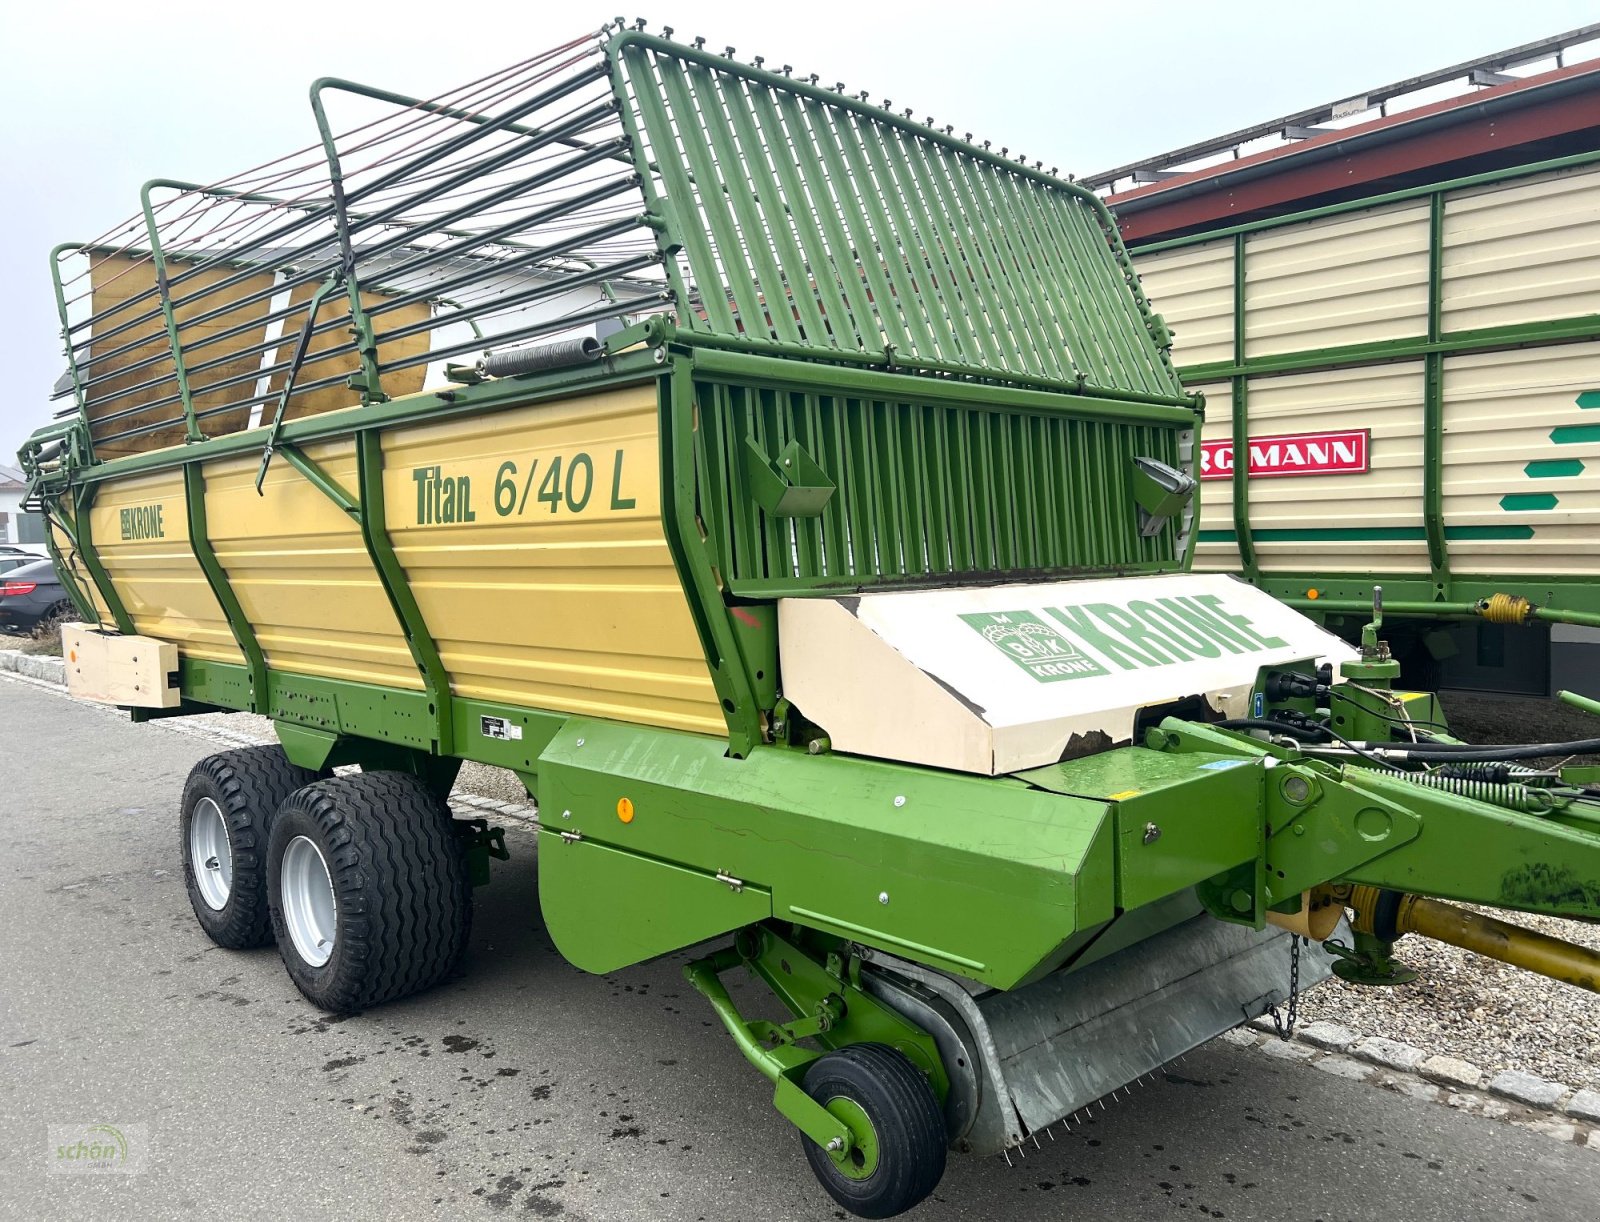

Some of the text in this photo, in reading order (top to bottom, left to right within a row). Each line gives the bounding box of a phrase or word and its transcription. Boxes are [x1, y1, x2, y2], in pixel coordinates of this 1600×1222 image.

[1200, 440, 1357, 473] RGMANN
[412, 449, 636, 525] Titan 6/40 L
[130, 504, 165, 540] KRONE
[1041, 594, 1291, 670] KRONE
[1029, 659, 1099, 677] KRONE
